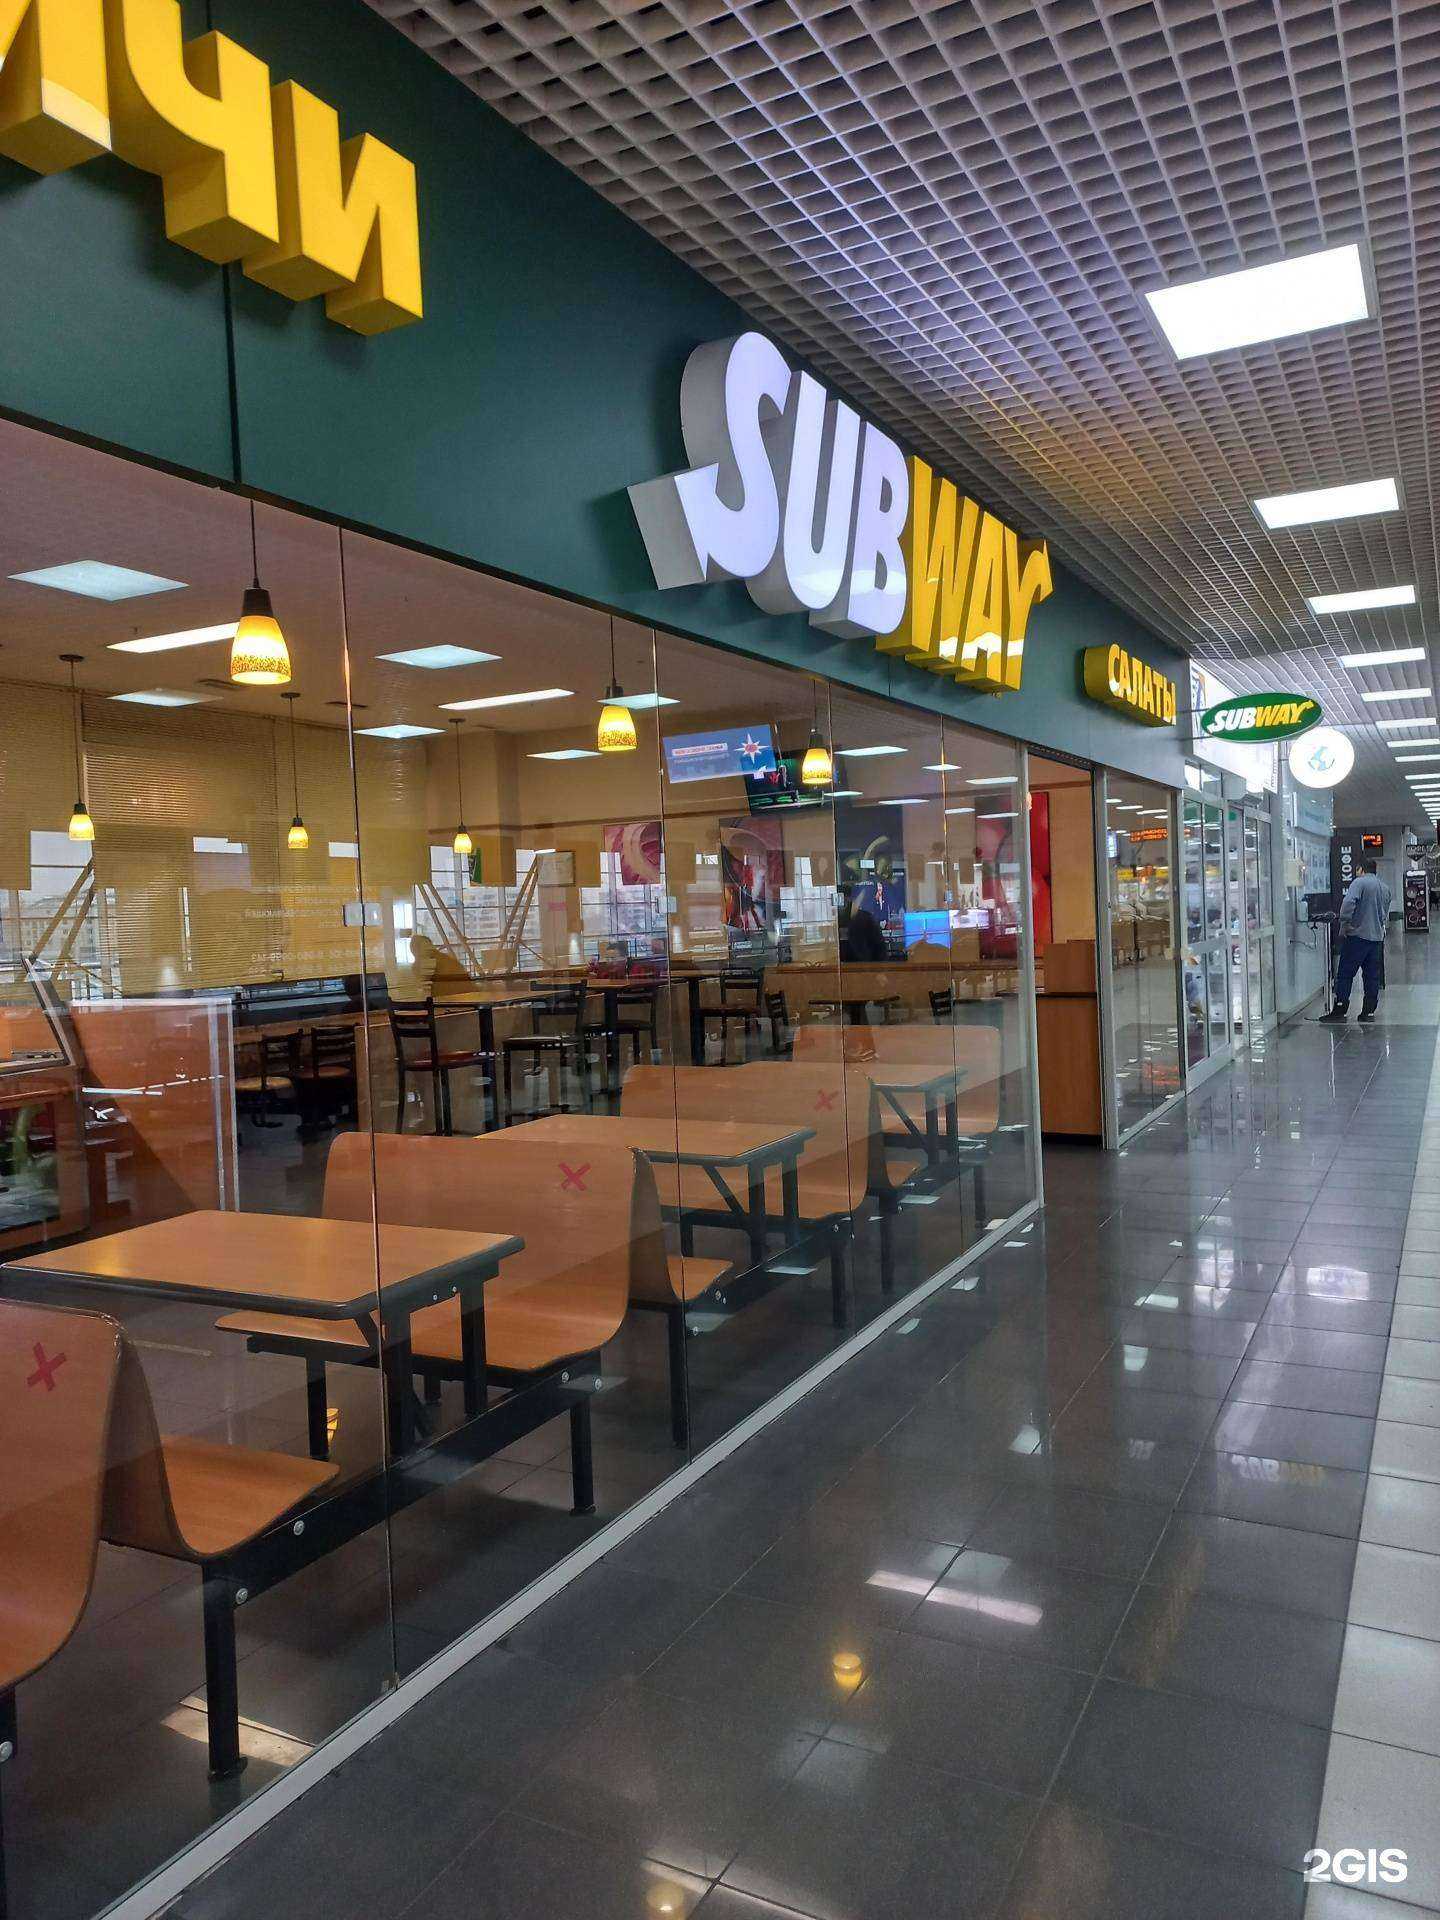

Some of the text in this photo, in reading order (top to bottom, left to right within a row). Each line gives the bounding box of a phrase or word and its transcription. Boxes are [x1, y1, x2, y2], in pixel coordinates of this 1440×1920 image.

[672, 331, 1053, 691] SUBWAY
[1107, 643, 1176, 725] САЛАТЫ
[1206, 700, 1315, 734] SUBWAY
